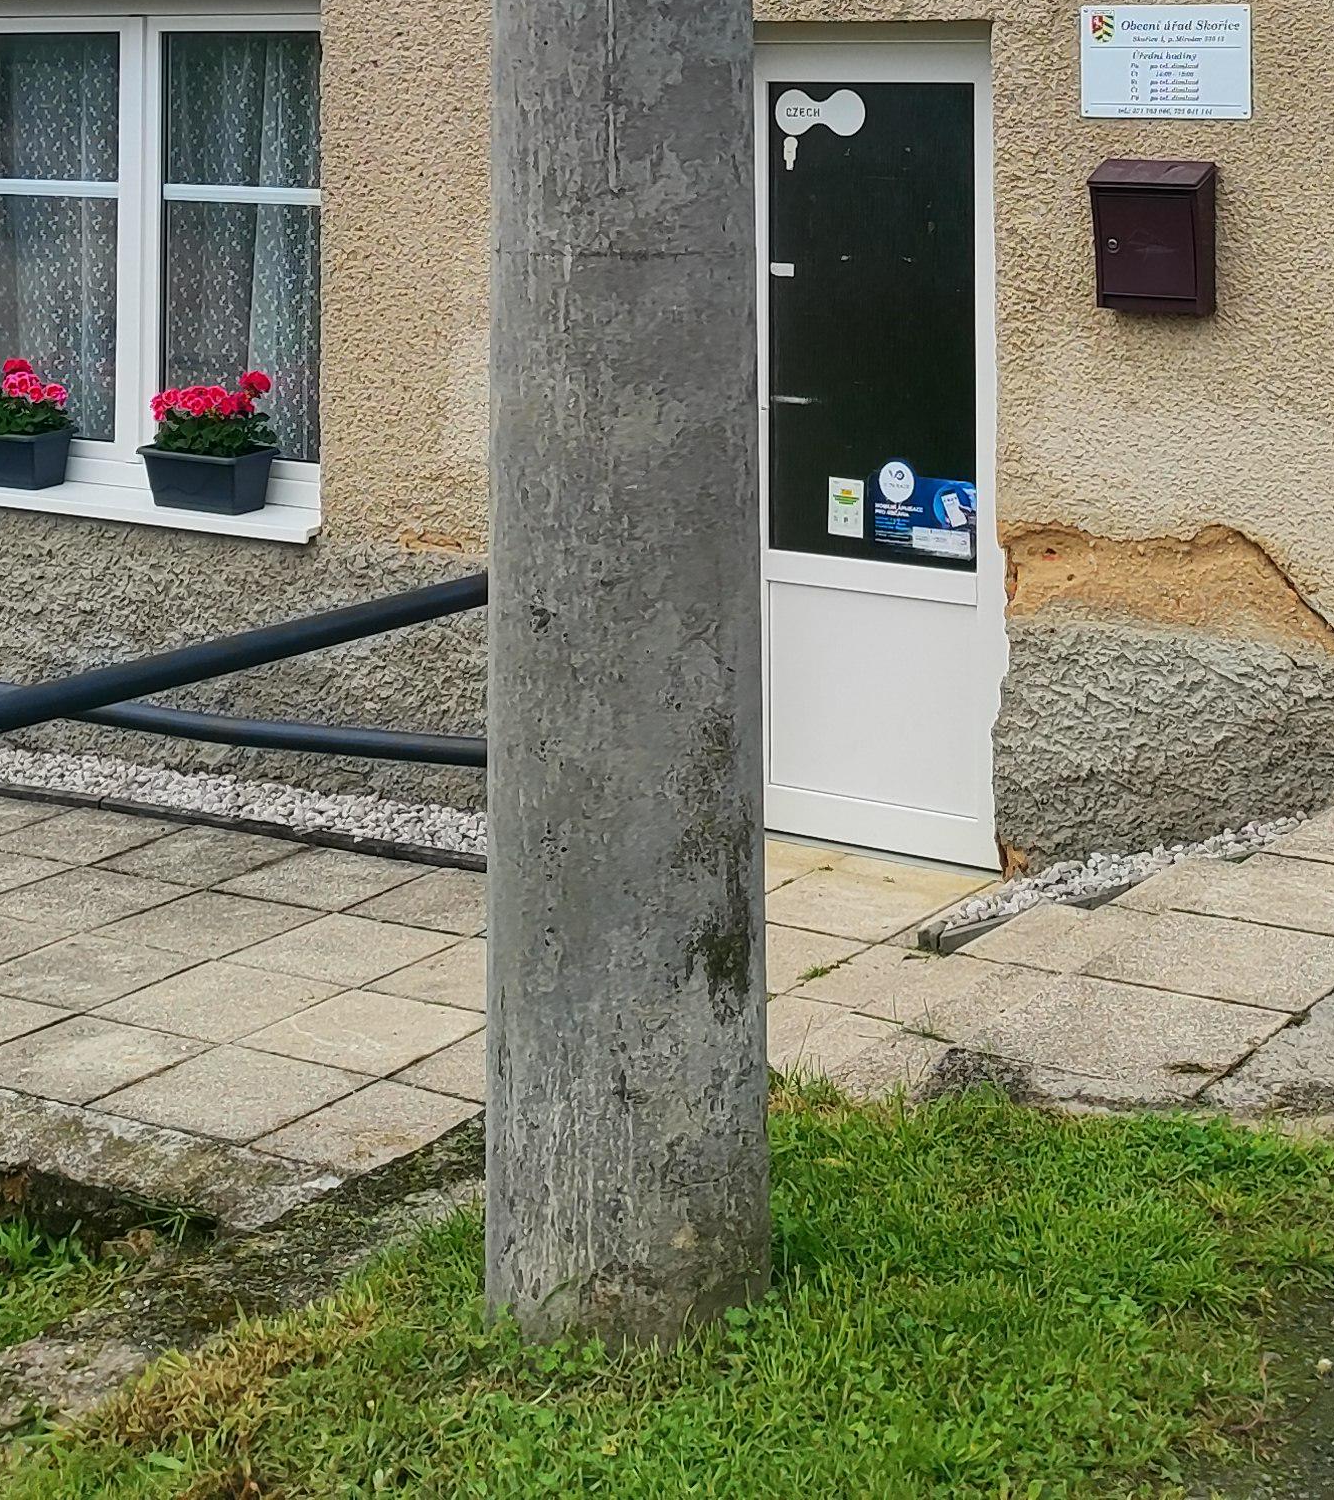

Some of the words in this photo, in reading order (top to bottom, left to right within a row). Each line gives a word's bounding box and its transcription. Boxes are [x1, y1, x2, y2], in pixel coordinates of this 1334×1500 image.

[1121, 20, 1160, 31] Obecní
[1164, 20, 1193, 31] úřad
[1196, 19, 1240, 31] Skořice
[1132, 49, 1163, 60] Úřední
[1166, 51, 1197, 61] hodiny
[786, 107, 820, 117] CZECH
